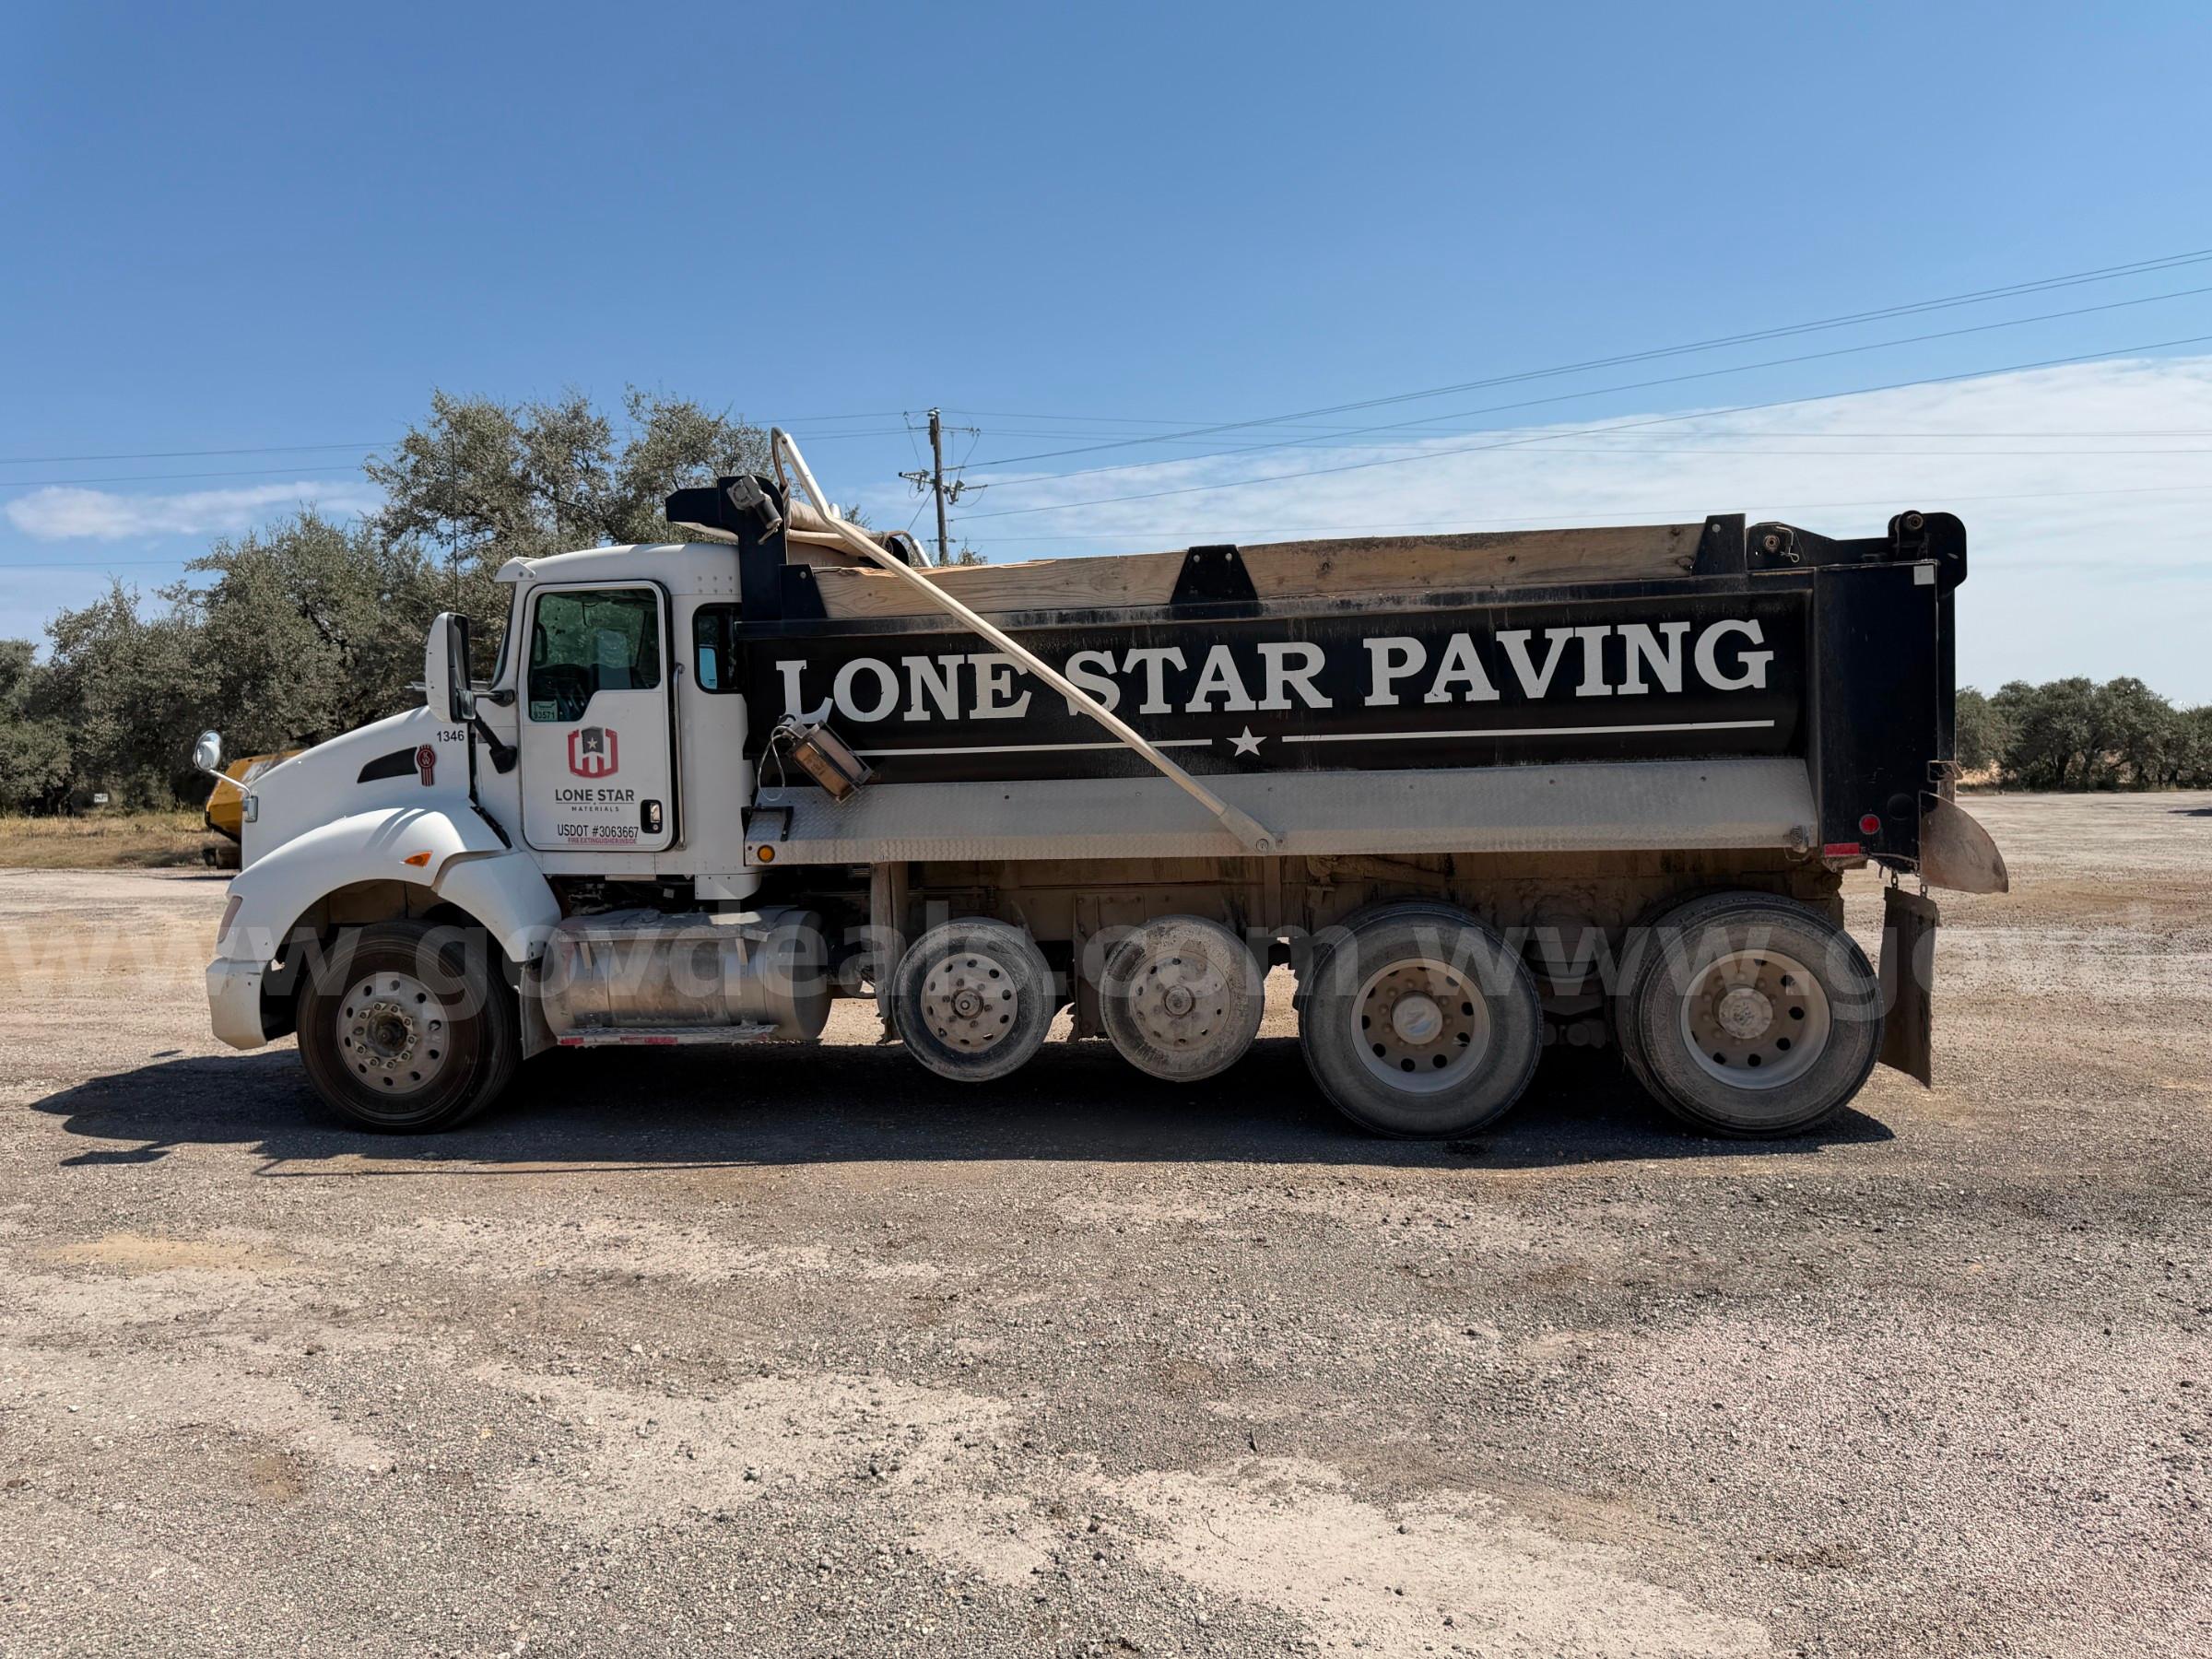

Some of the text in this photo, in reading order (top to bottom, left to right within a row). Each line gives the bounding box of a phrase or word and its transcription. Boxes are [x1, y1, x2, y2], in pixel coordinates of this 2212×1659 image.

[775, 618, 1774, 726] LONE STAR PAVING
[436, 730, 465, 742] 1346
[555, 789, 635, 801] LONE STAR
[558, 824, 639, 838] USDOT #3063667
